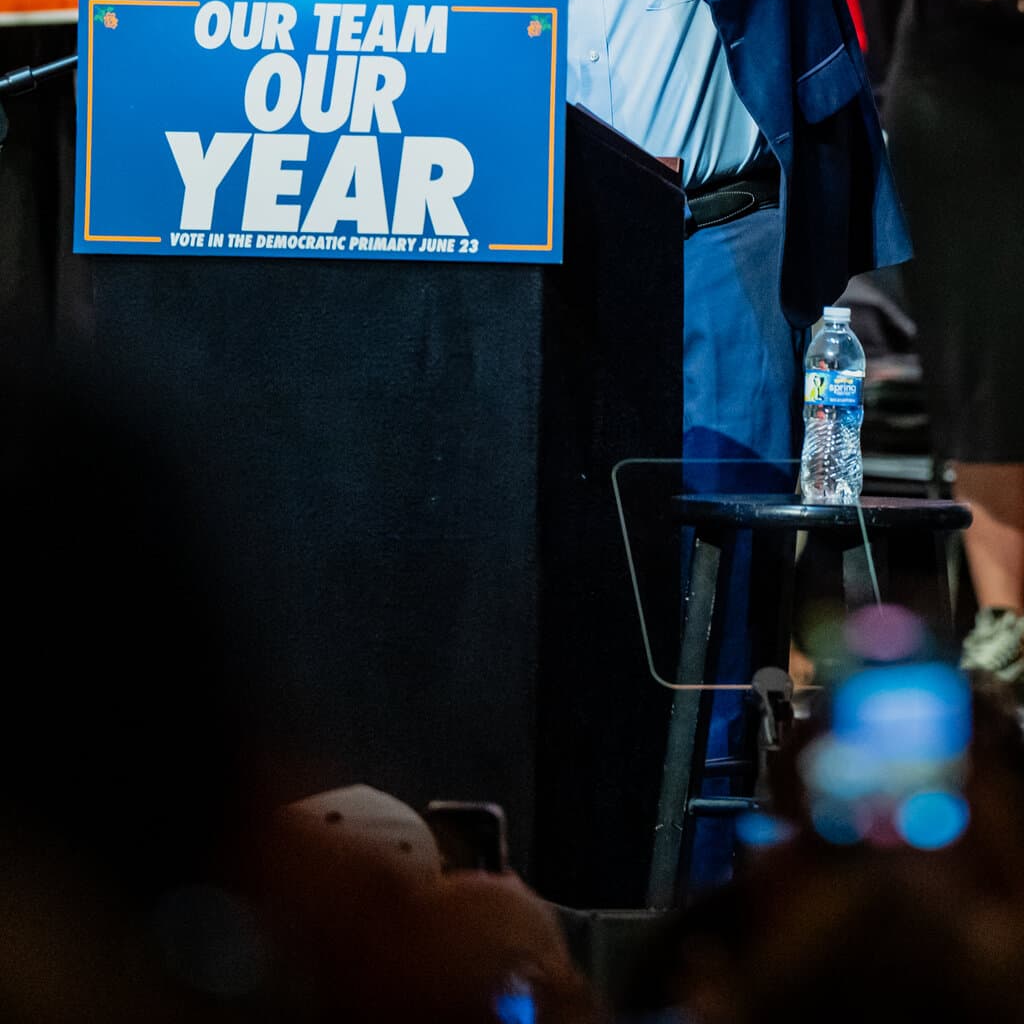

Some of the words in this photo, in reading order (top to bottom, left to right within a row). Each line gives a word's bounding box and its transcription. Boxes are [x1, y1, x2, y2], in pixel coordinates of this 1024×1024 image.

[194, 0, 298, 51] OUR
[313, 3, 449, 54] TEAM
[244, 52, 407, 134] OUR
[164, 131, 475, 236] YEAR
[170, 232, 205, 248] VOTE
[208, 233, 224, 248] IN
[228, 233, 253, 249] THE
[256, 234, 346, 251] DEMOCRATIC
[349, 236, 417, 252] PRIMARY
[418, 238, 456, 253] JUNE
[458, 238, 480, 254] 23
[829, 384, 857, 395] spring
